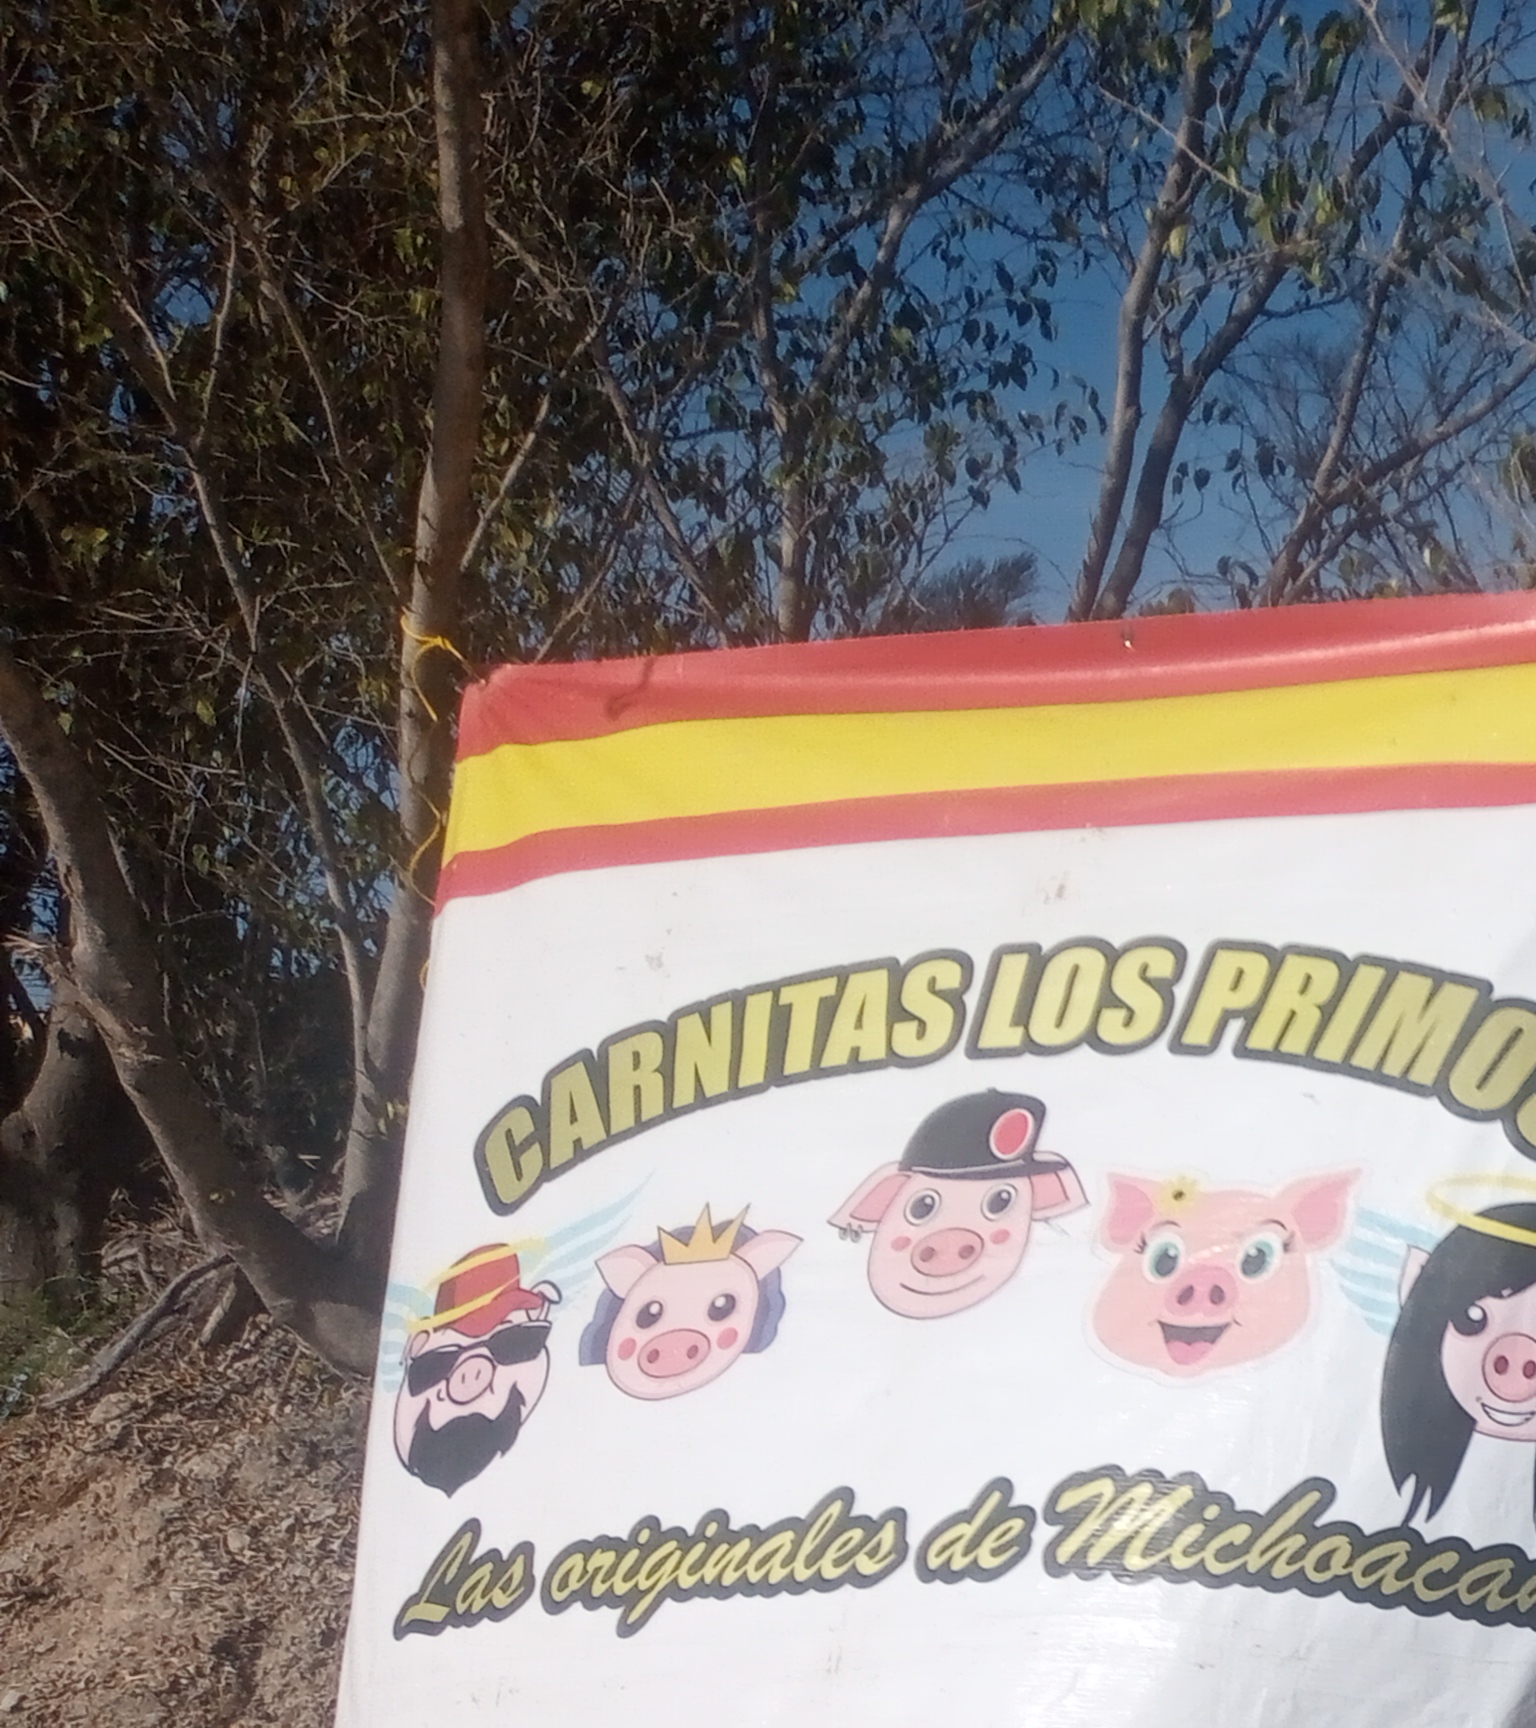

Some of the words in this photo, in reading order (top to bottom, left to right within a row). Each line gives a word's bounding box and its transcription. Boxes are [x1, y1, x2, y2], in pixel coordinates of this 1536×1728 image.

[477, 950, 971, 1213] CARNITAS
[967, 938, 1186, 1058] LOS
[396, 1520, 533, 1638] Las
[542, 1488, 906, 1636] originales
[917, 1479, 1034, 1581] de
